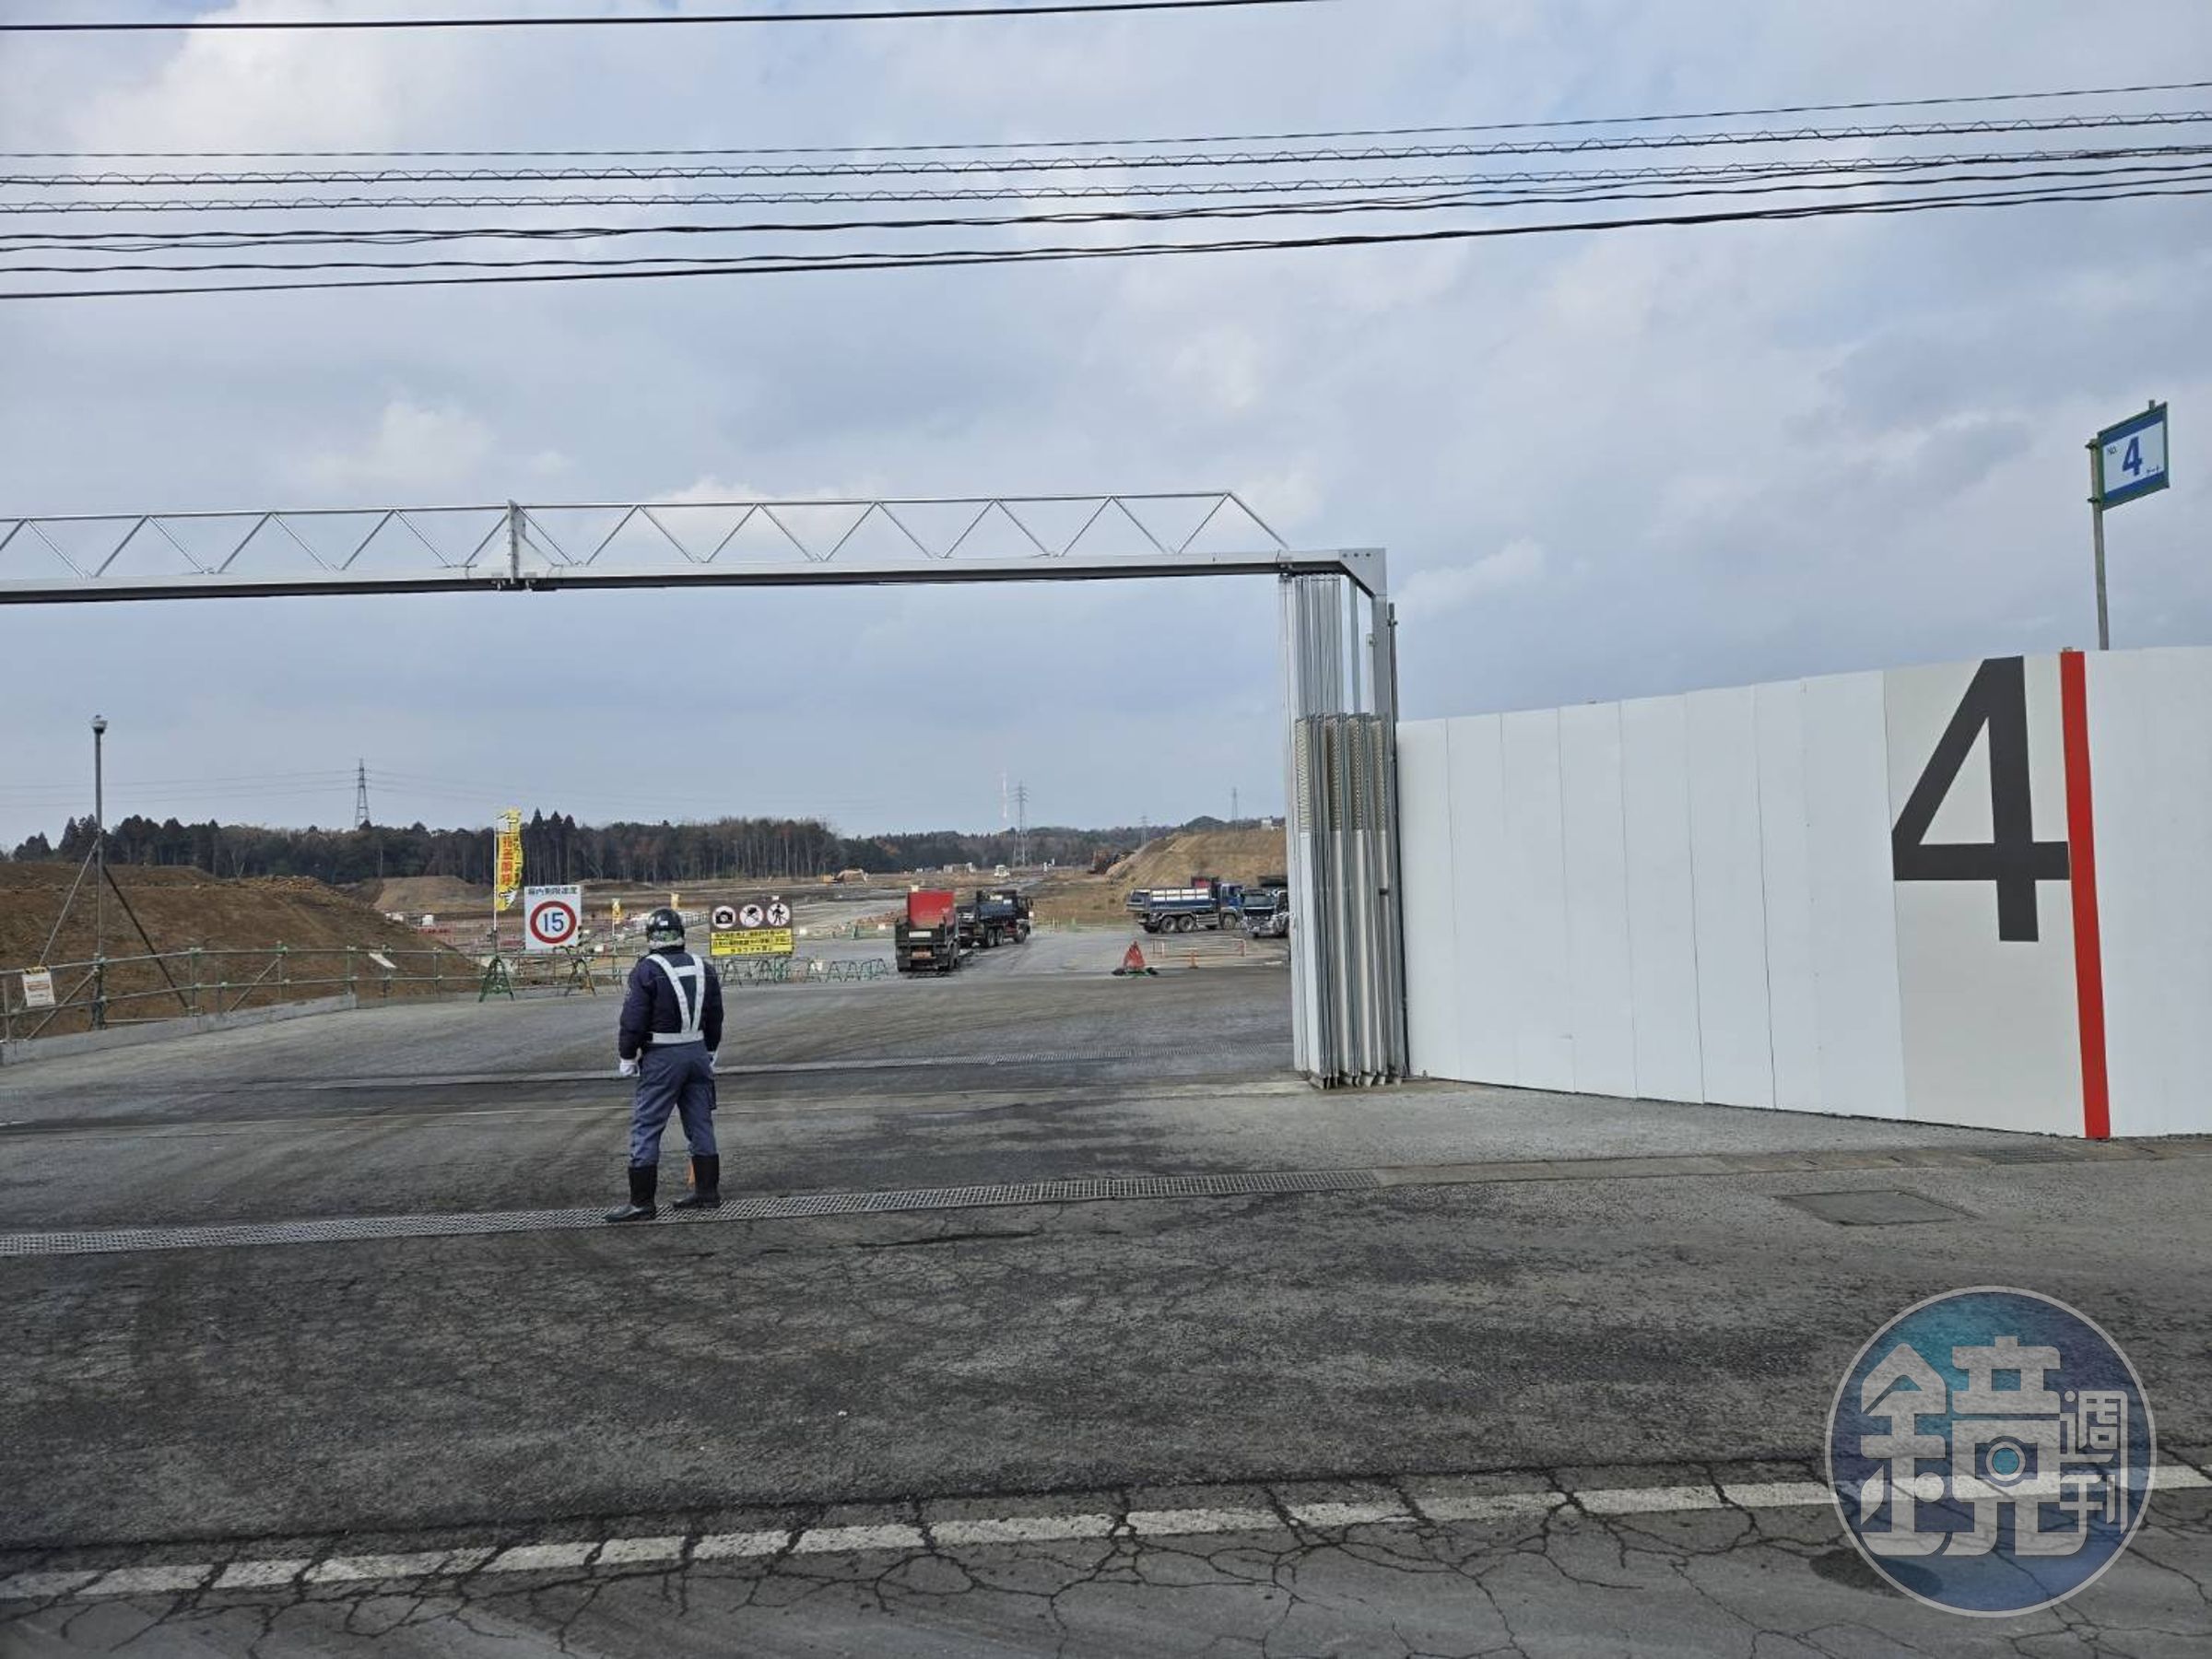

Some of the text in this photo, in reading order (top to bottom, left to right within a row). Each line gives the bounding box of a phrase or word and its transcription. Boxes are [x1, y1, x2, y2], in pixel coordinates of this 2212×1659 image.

[2122, 435, 2143, 477] 4
[1891, 655, 2071, 942] 4
[544, 912, 564, 933] 15
